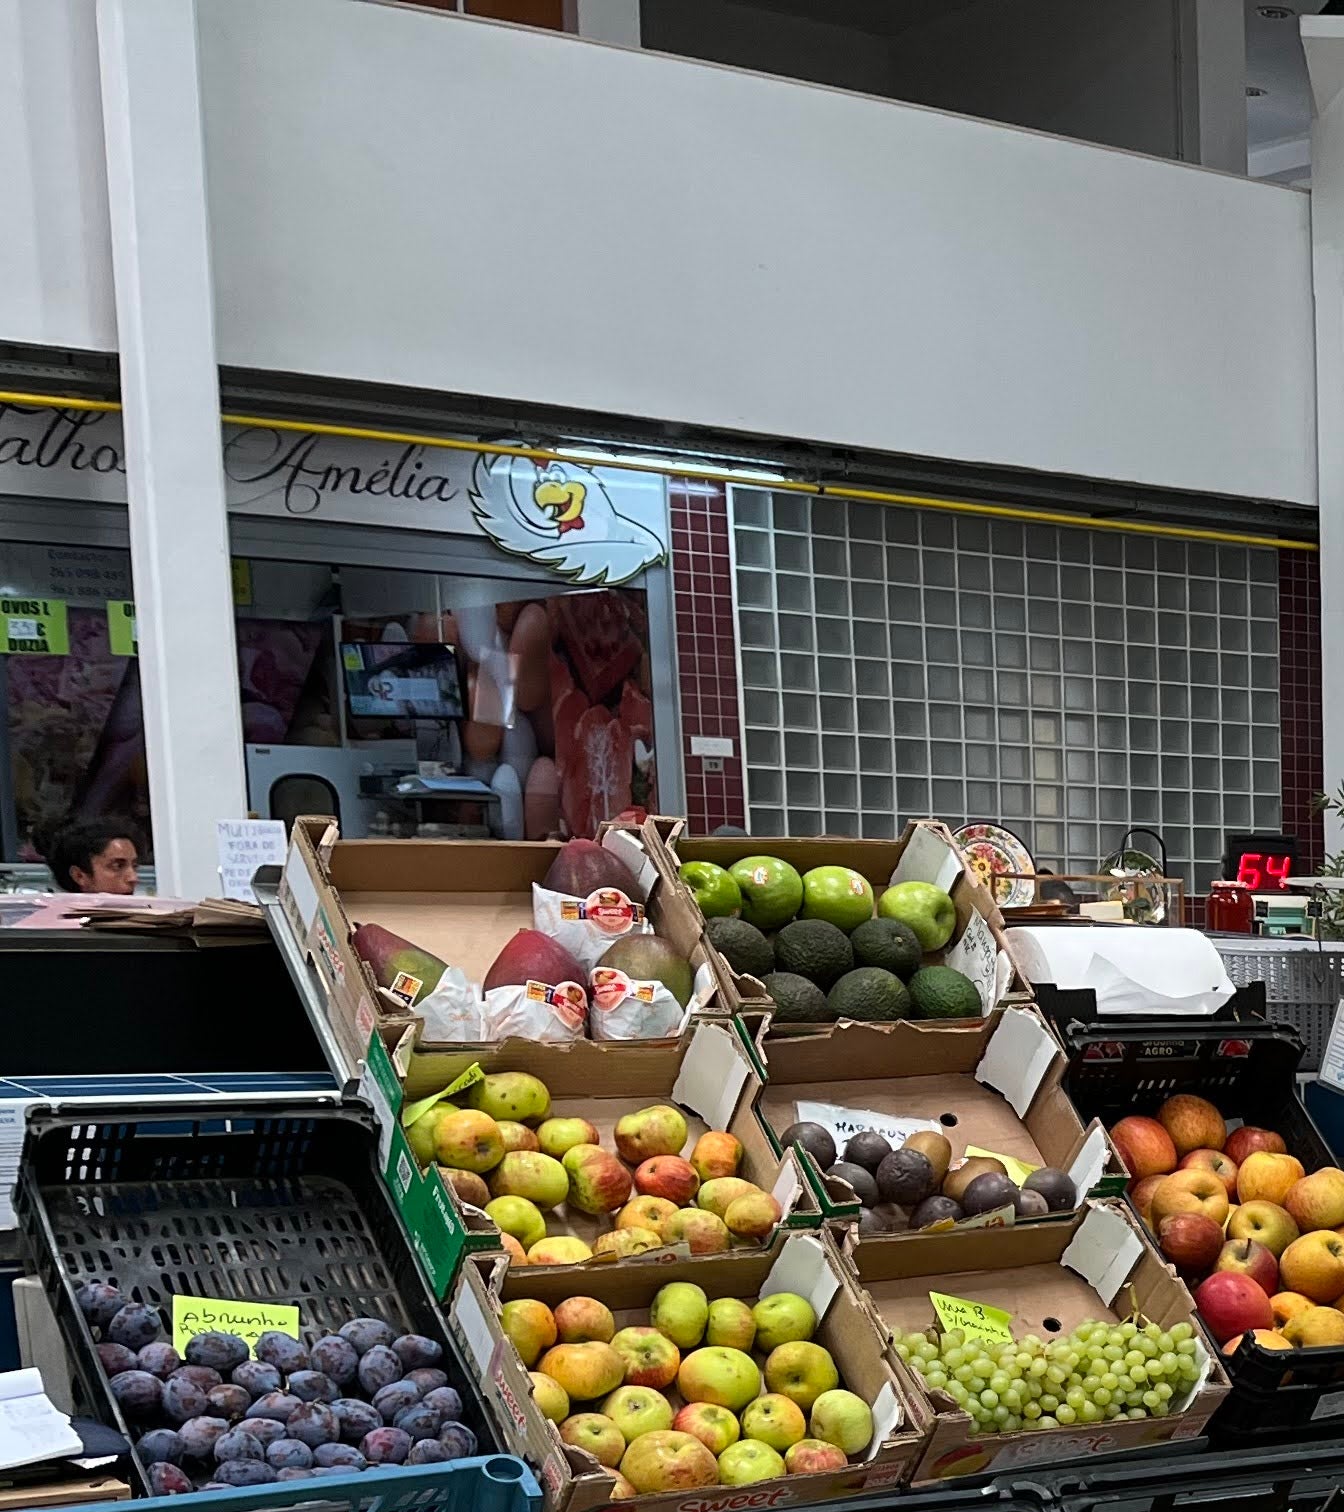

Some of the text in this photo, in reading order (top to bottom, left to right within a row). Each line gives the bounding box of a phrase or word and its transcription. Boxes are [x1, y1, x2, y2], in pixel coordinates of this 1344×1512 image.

[224, 427, 458, 514] Amélia
[1, 600, 41, 615] OVOS
[1237, 853, 1290, 890] 64
[1144, 1047, 1173, 1057] AGRO
[184, 1308, 287, 1326] Abrunho
